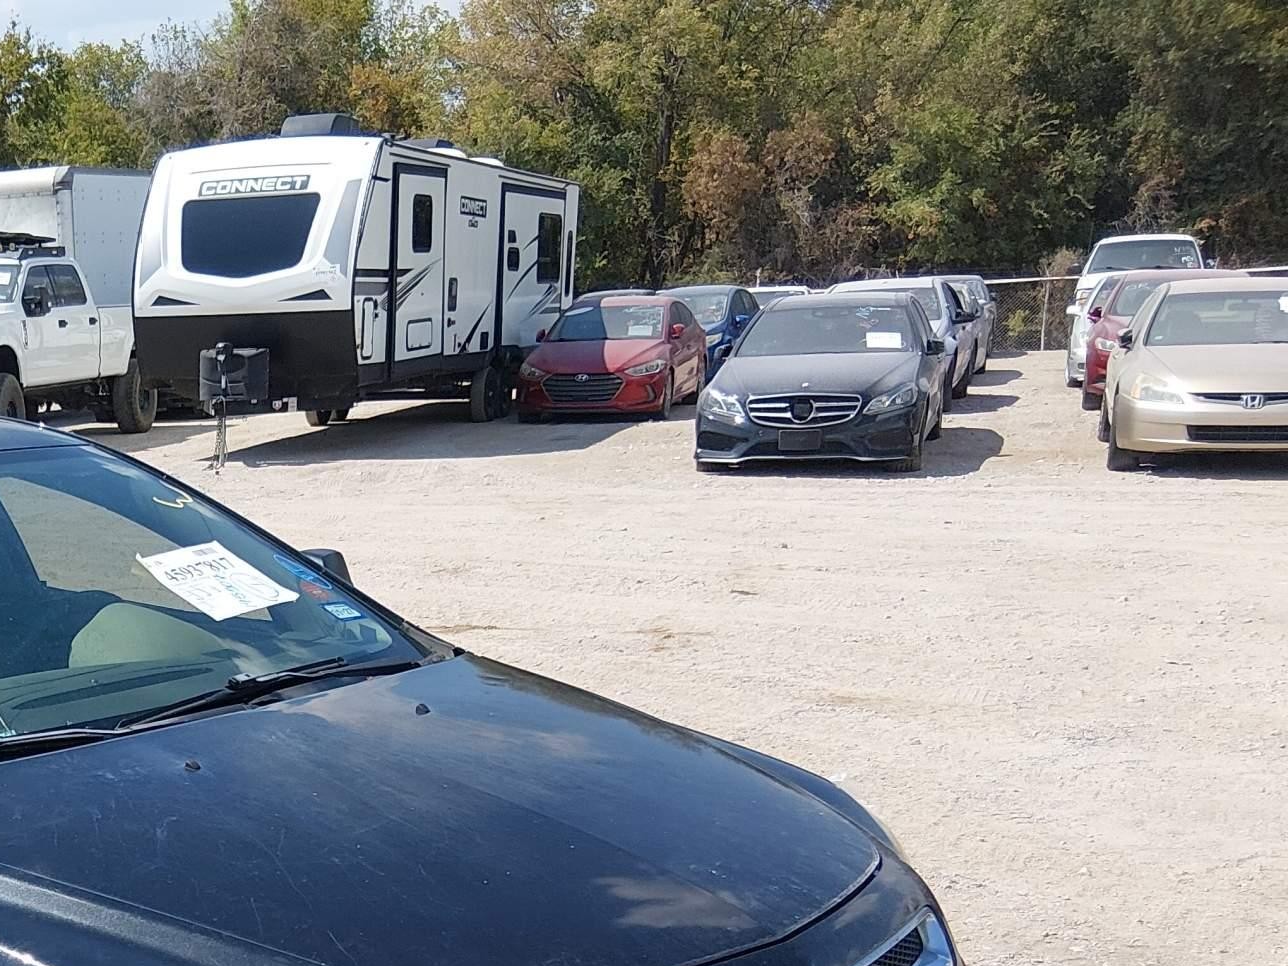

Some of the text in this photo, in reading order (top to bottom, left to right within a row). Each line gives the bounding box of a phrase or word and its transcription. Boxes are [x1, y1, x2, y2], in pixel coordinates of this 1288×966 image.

[200, 175, 308, 196] CONNECT
[460, 198, 487, 216] CONNECT
[163, 556, 236, 583] 45937817
